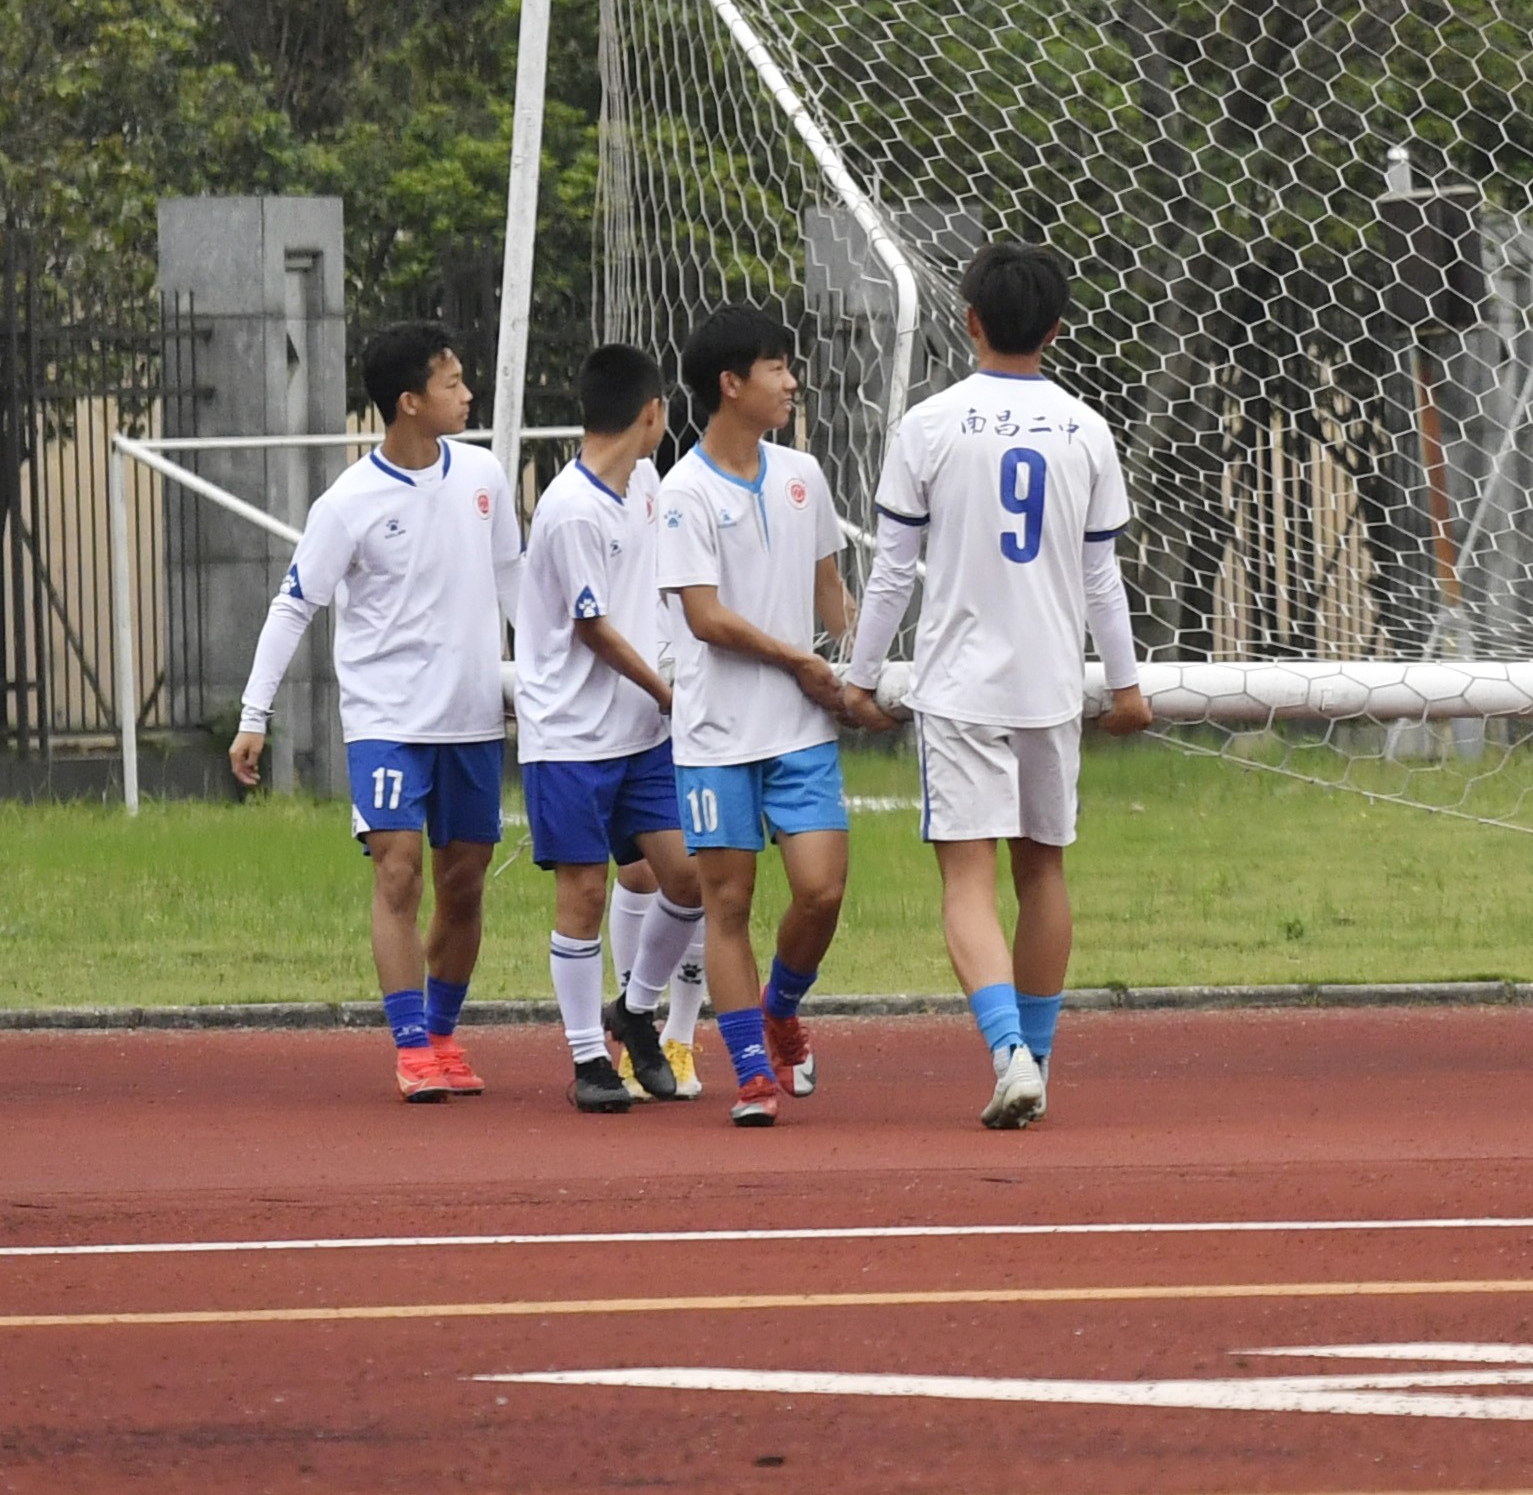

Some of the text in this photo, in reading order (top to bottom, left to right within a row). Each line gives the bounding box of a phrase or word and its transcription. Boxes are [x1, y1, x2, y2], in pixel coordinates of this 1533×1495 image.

[961, 407, 1080, 445] 南昌二中
[1000, 447, 1047, 563] 9
[372, 767, 404, 810] 17
[686, 788, 718, 833] 10
